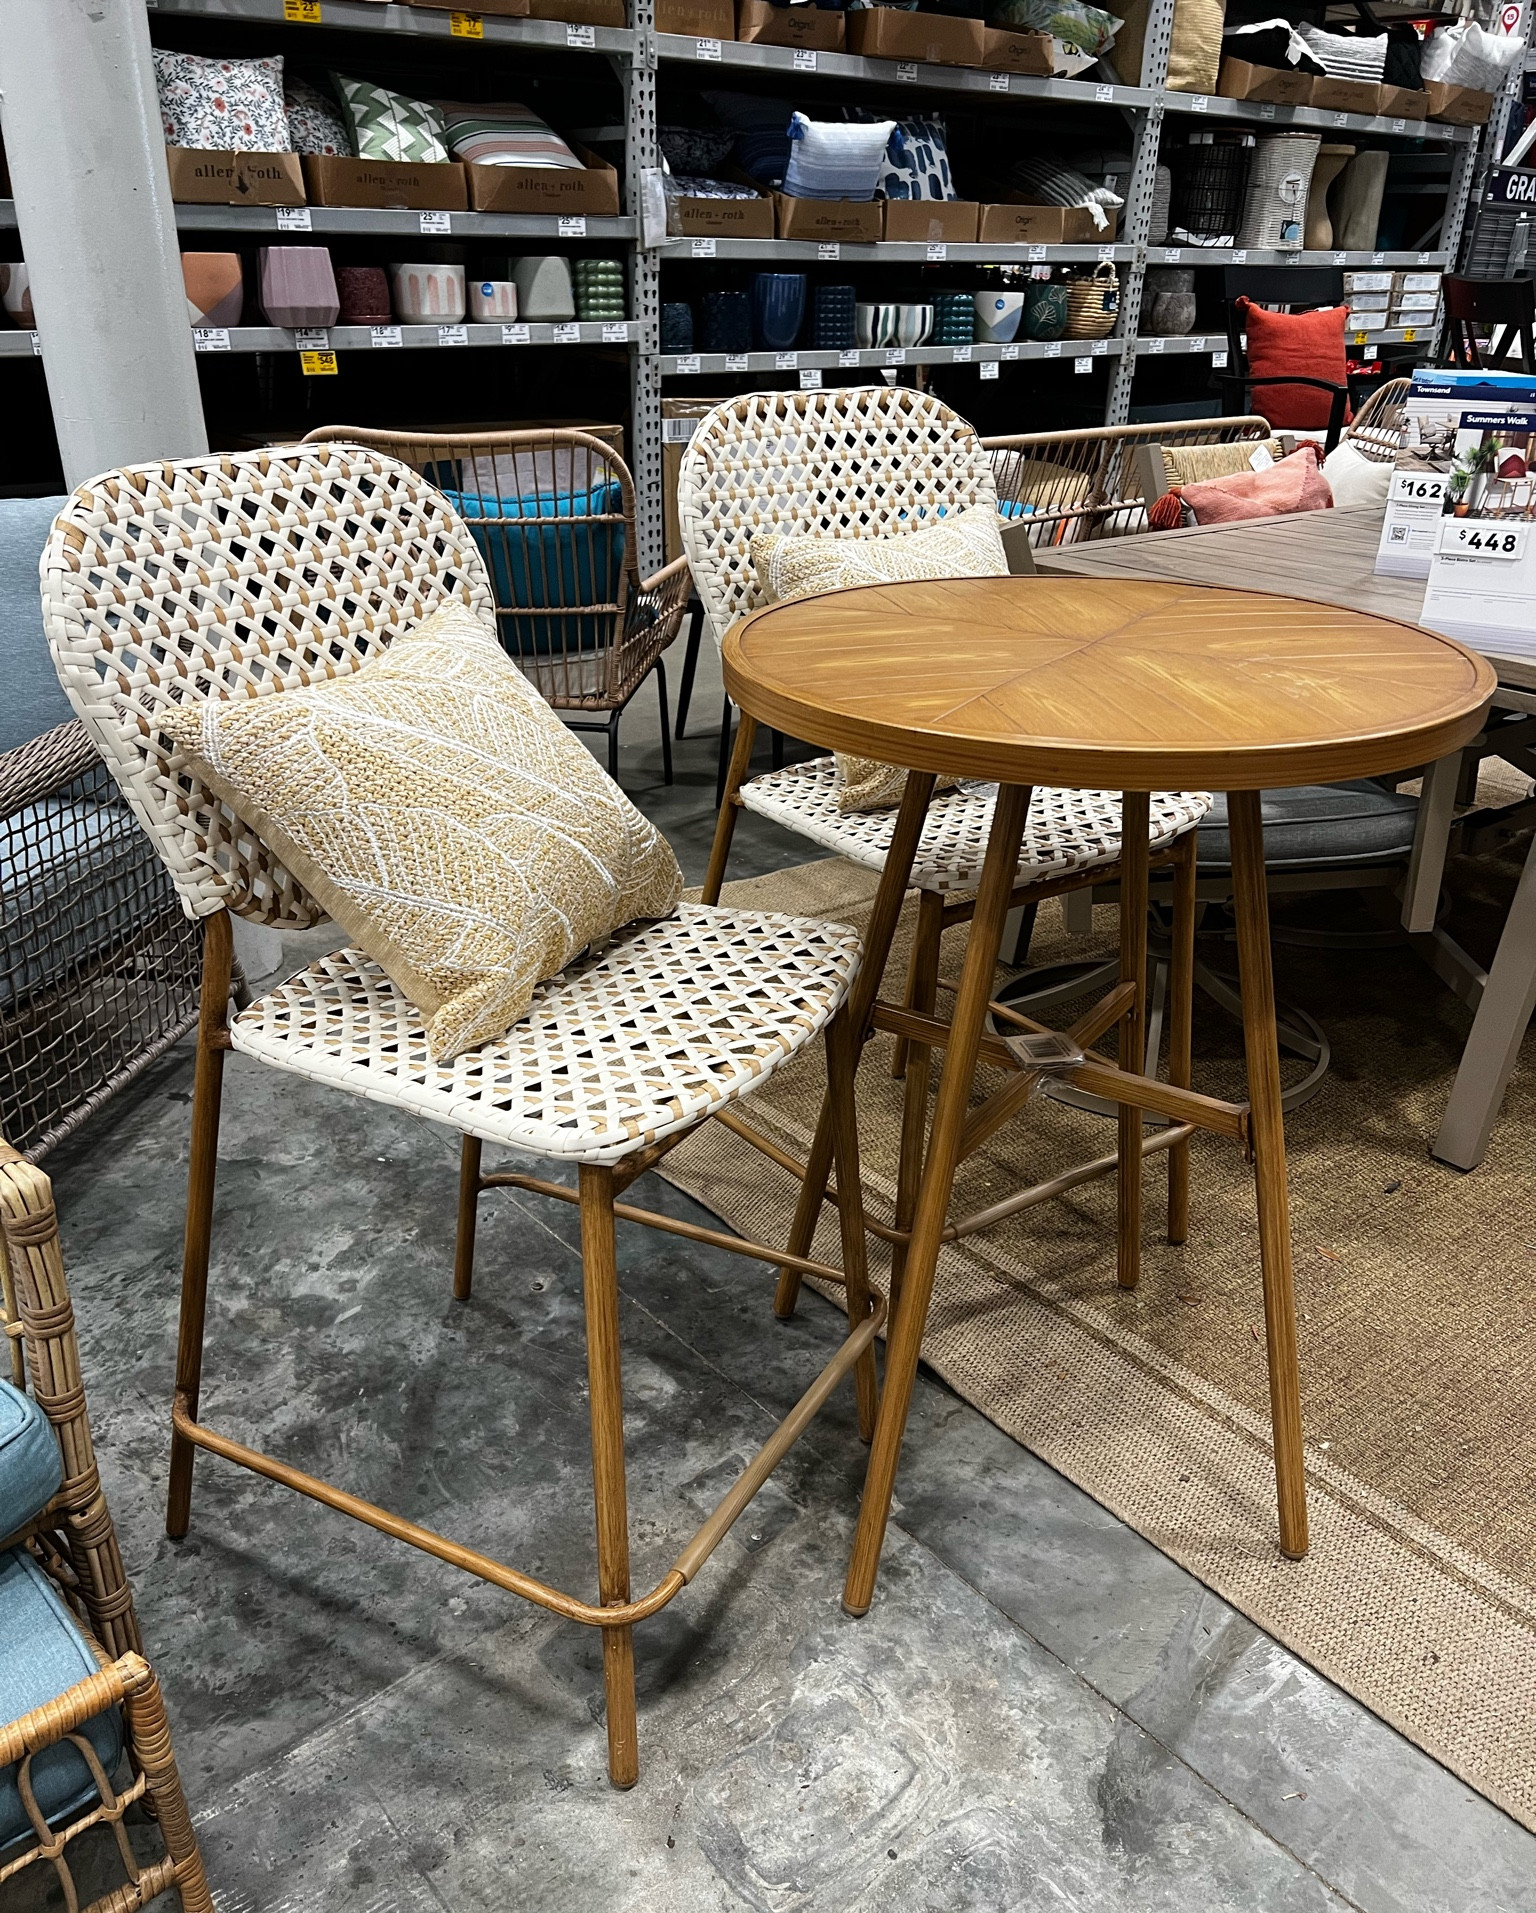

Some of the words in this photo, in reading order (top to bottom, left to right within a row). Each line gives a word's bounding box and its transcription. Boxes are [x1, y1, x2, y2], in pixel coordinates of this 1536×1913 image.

[356, 173, 386, 185] allen
[396, 175, 420, 187] roth
[516, 178, 548, 191] allen
[559, 180, 584, 192] roth
[1506, 174, 1536, 201] GRA
[684, 209, 712, 220] allen
[721, 209, 744, 220] roth
[1417, 385, 1452, 394] Townsend
[1466, 415, 1505, 424] Summers
[1507, 416, 1528, 425] Walk
[1400, 479, 1446, 498] $162
[1458, 529, 1517, 553] $448
